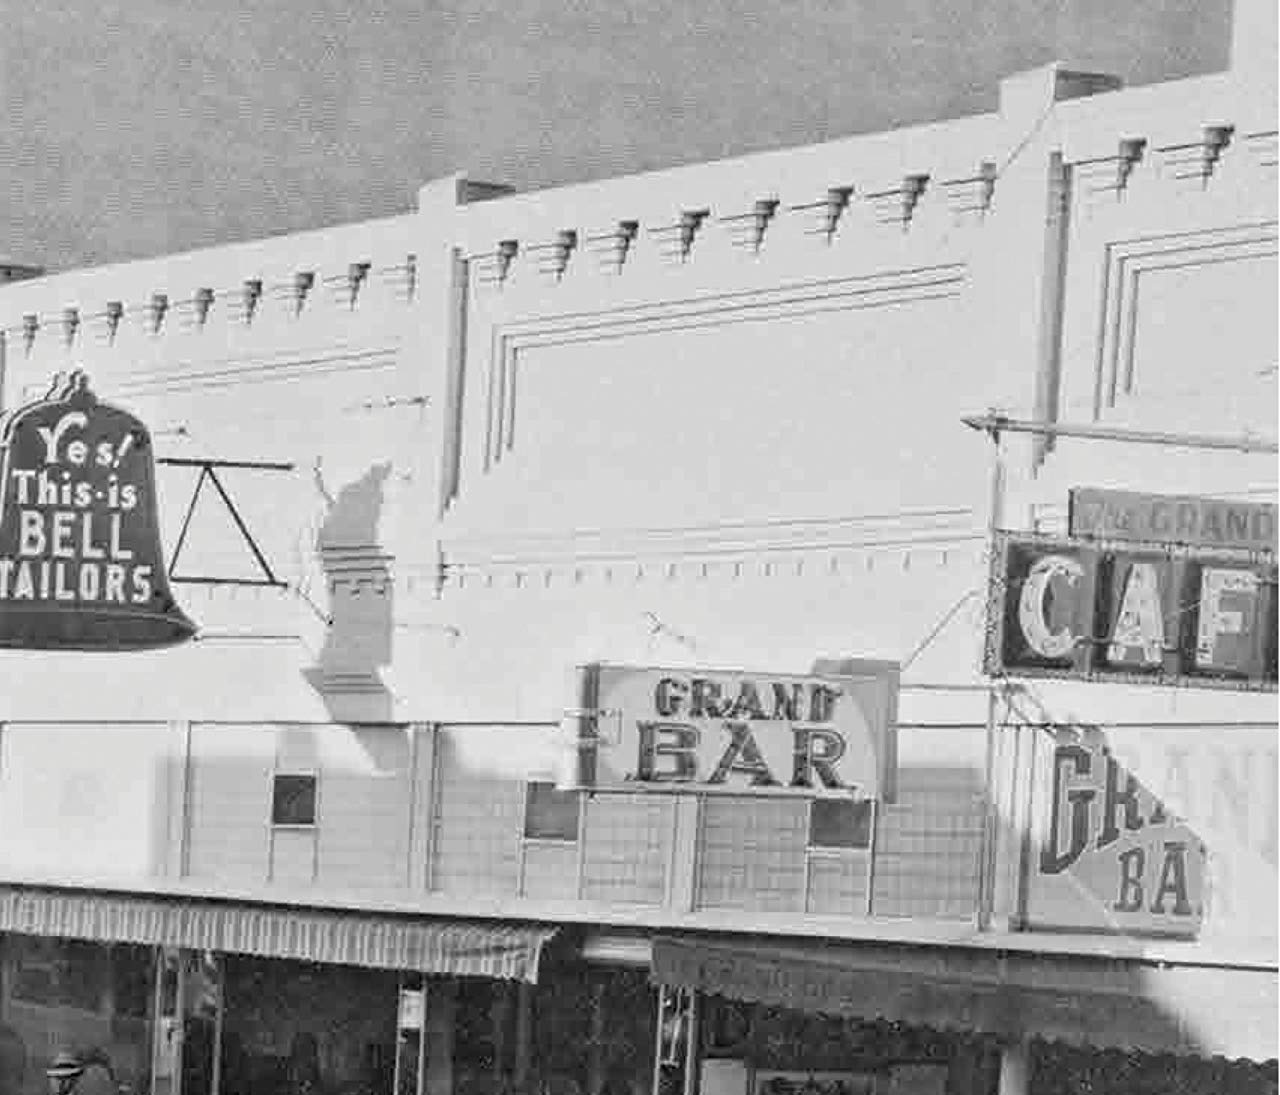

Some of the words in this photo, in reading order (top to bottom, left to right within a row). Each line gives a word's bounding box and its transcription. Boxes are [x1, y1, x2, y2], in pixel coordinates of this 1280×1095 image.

[37, 411, 134, 468] Yes!
[20, 510, 133, 560] BELL
[653, 677, 844, 722] GRAND
[625, 719, 860, 790] BAR
